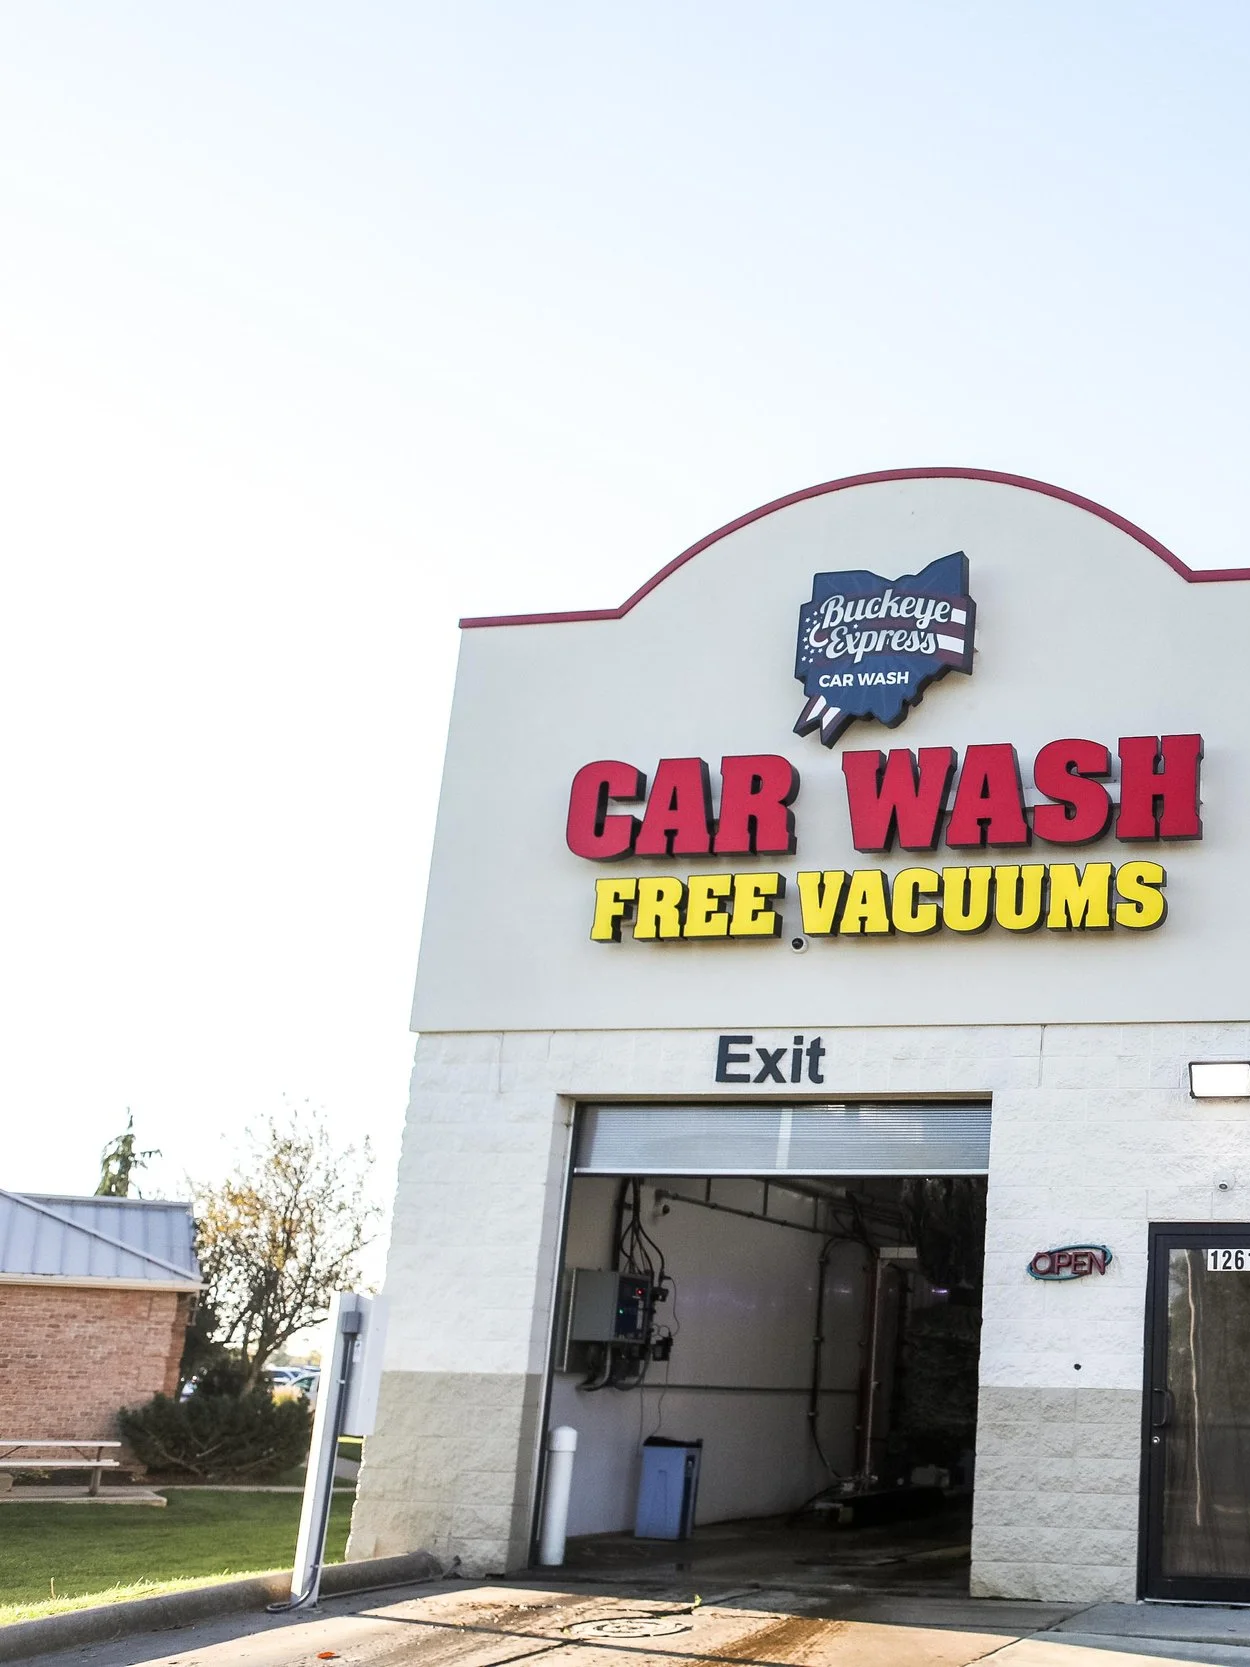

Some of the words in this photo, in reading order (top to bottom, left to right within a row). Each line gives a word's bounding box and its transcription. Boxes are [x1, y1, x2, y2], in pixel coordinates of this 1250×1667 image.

[820, 589, 951, 630] Buckeye
[824, 625, 937, 664] Express
[818, 674, 853, 688] CAR
[858, 671, 909, 686] WASH
[566, 754, 800, 862] CAR
[842, 733, 1203, 853] WASH
[590, 872, 786, 943] FREE
[797, 860, 1168, 938] VACUUMS
[715, 1035, 826, 1084] Exit
[1031, 1252, 1106, 1276] OPEN
